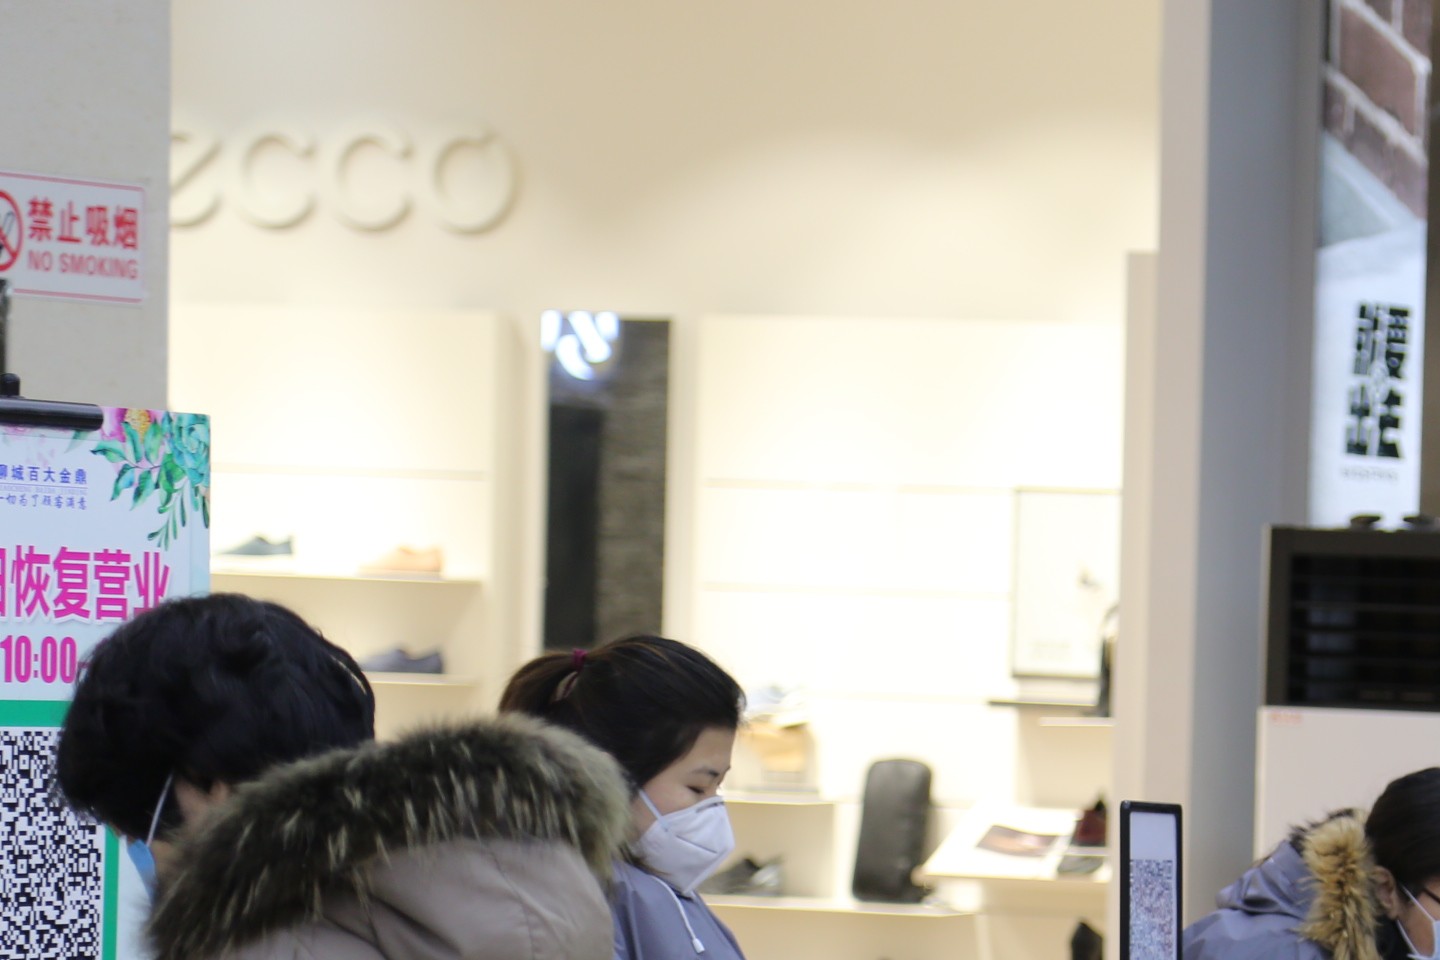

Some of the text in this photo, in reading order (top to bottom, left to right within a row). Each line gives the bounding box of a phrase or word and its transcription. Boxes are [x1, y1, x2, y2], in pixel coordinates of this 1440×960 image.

[28, 196, 139, 250] 禁止吸烟
[28, 250, 139, 281] NO SMOKING
[0, 545, 170, 622] 恢复营业
